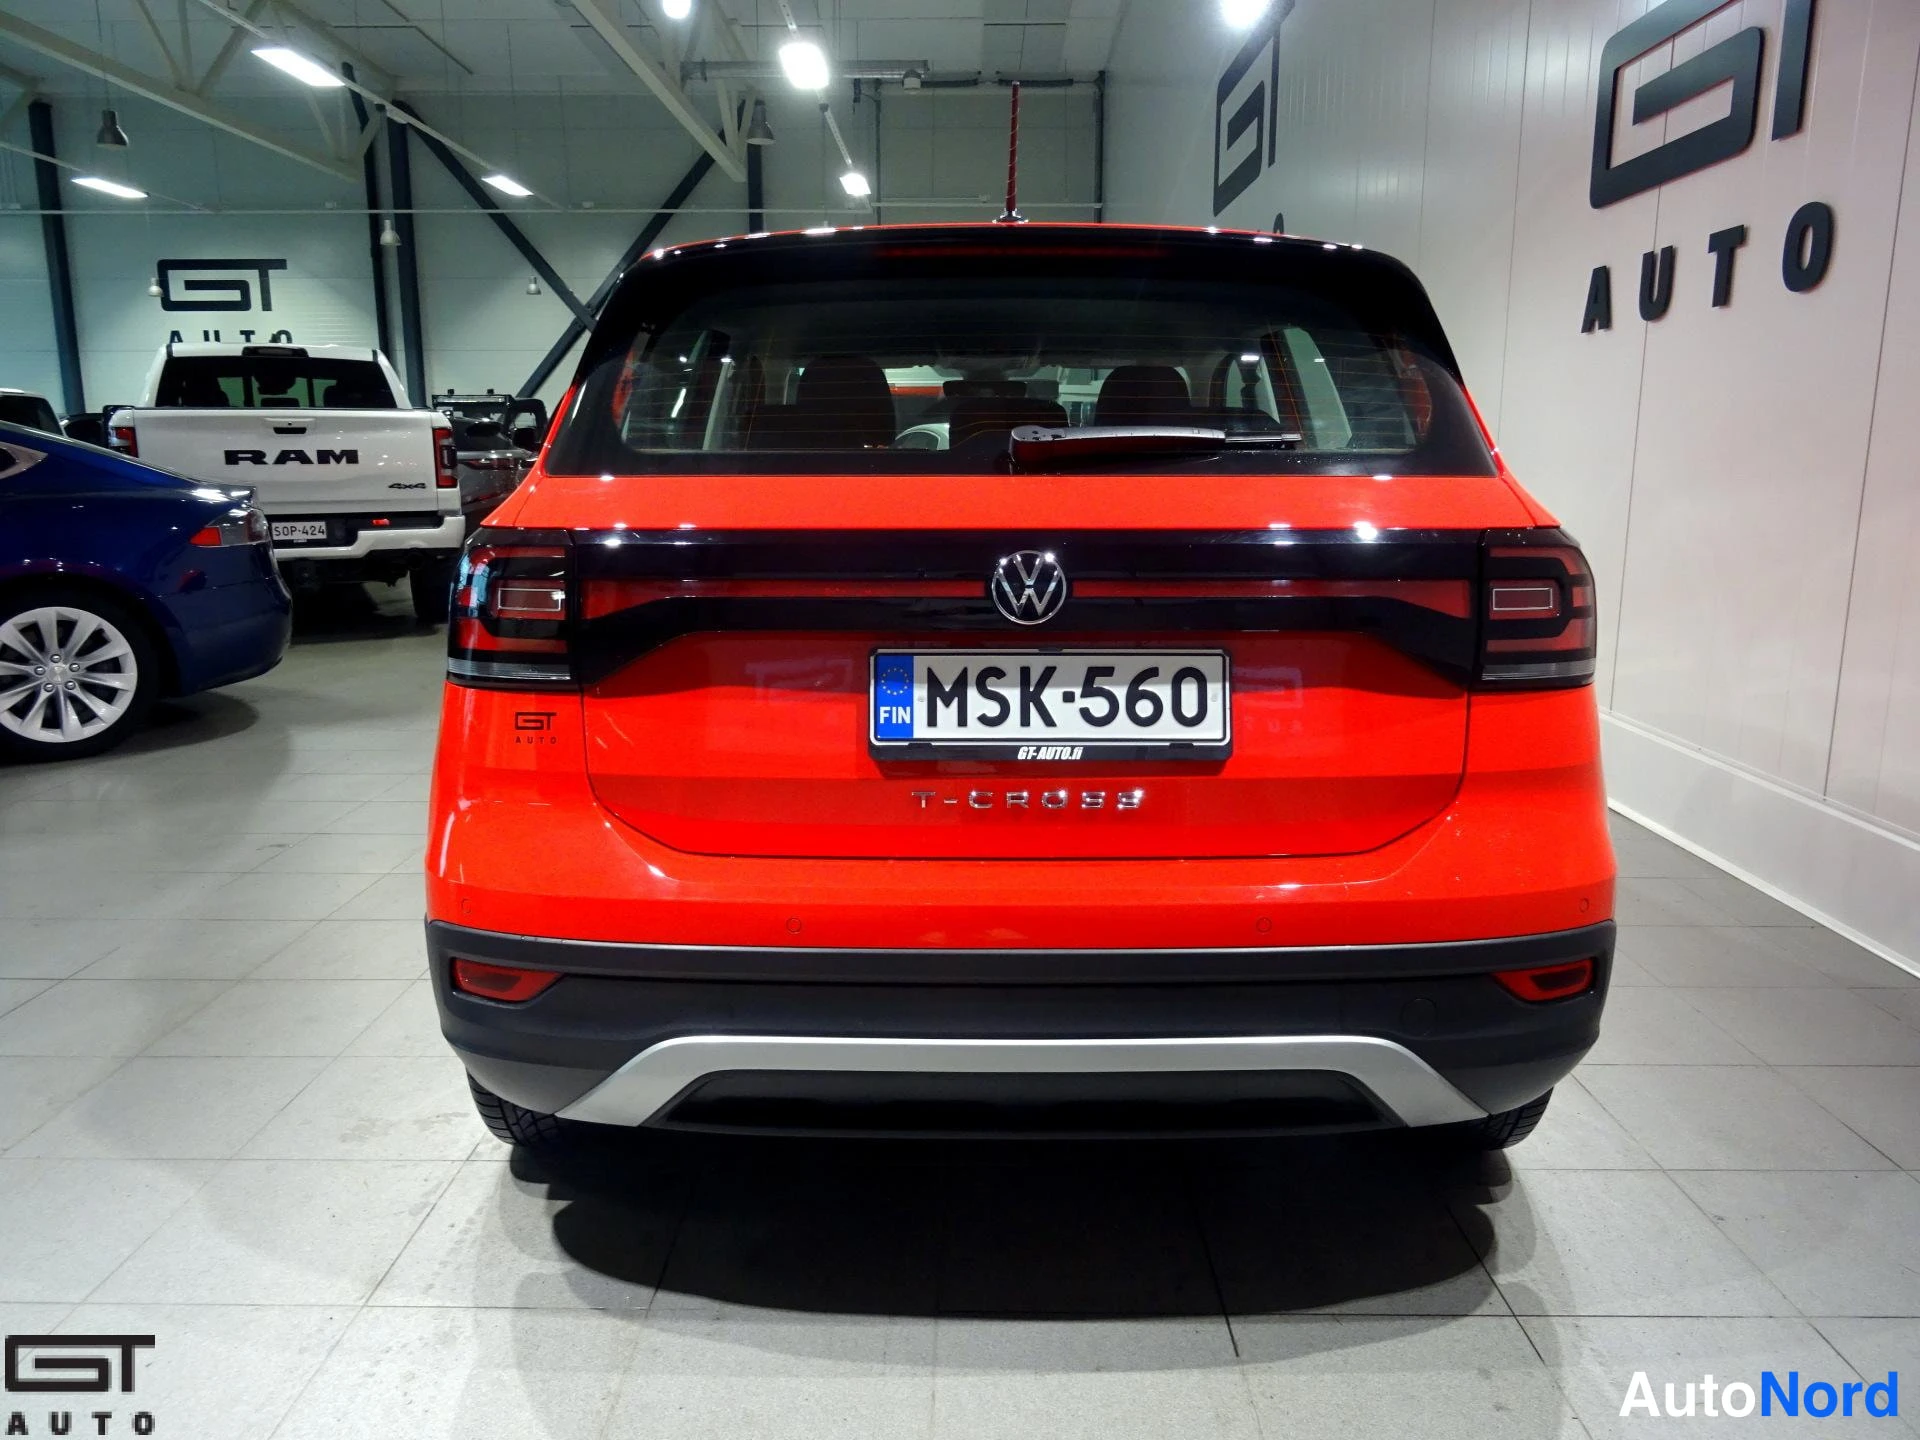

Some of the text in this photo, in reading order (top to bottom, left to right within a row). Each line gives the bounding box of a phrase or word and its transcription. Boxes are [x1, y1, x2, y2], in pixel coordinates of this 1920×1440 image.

[1581, 201, 1834, 334] AUTO
[157, 258, 288, 312] GT
[224, 449, 360, 466] RAM
[274, 525, 325, 537] SOP-424
[926, 665, 1208, 728] MSK-560
[514, 711, 557, 731] GT
[879, 706, 911, 724] FIN
[515, 735, 557, 745] AUTO
[911, 789, 1144, 810] T-CROSS
